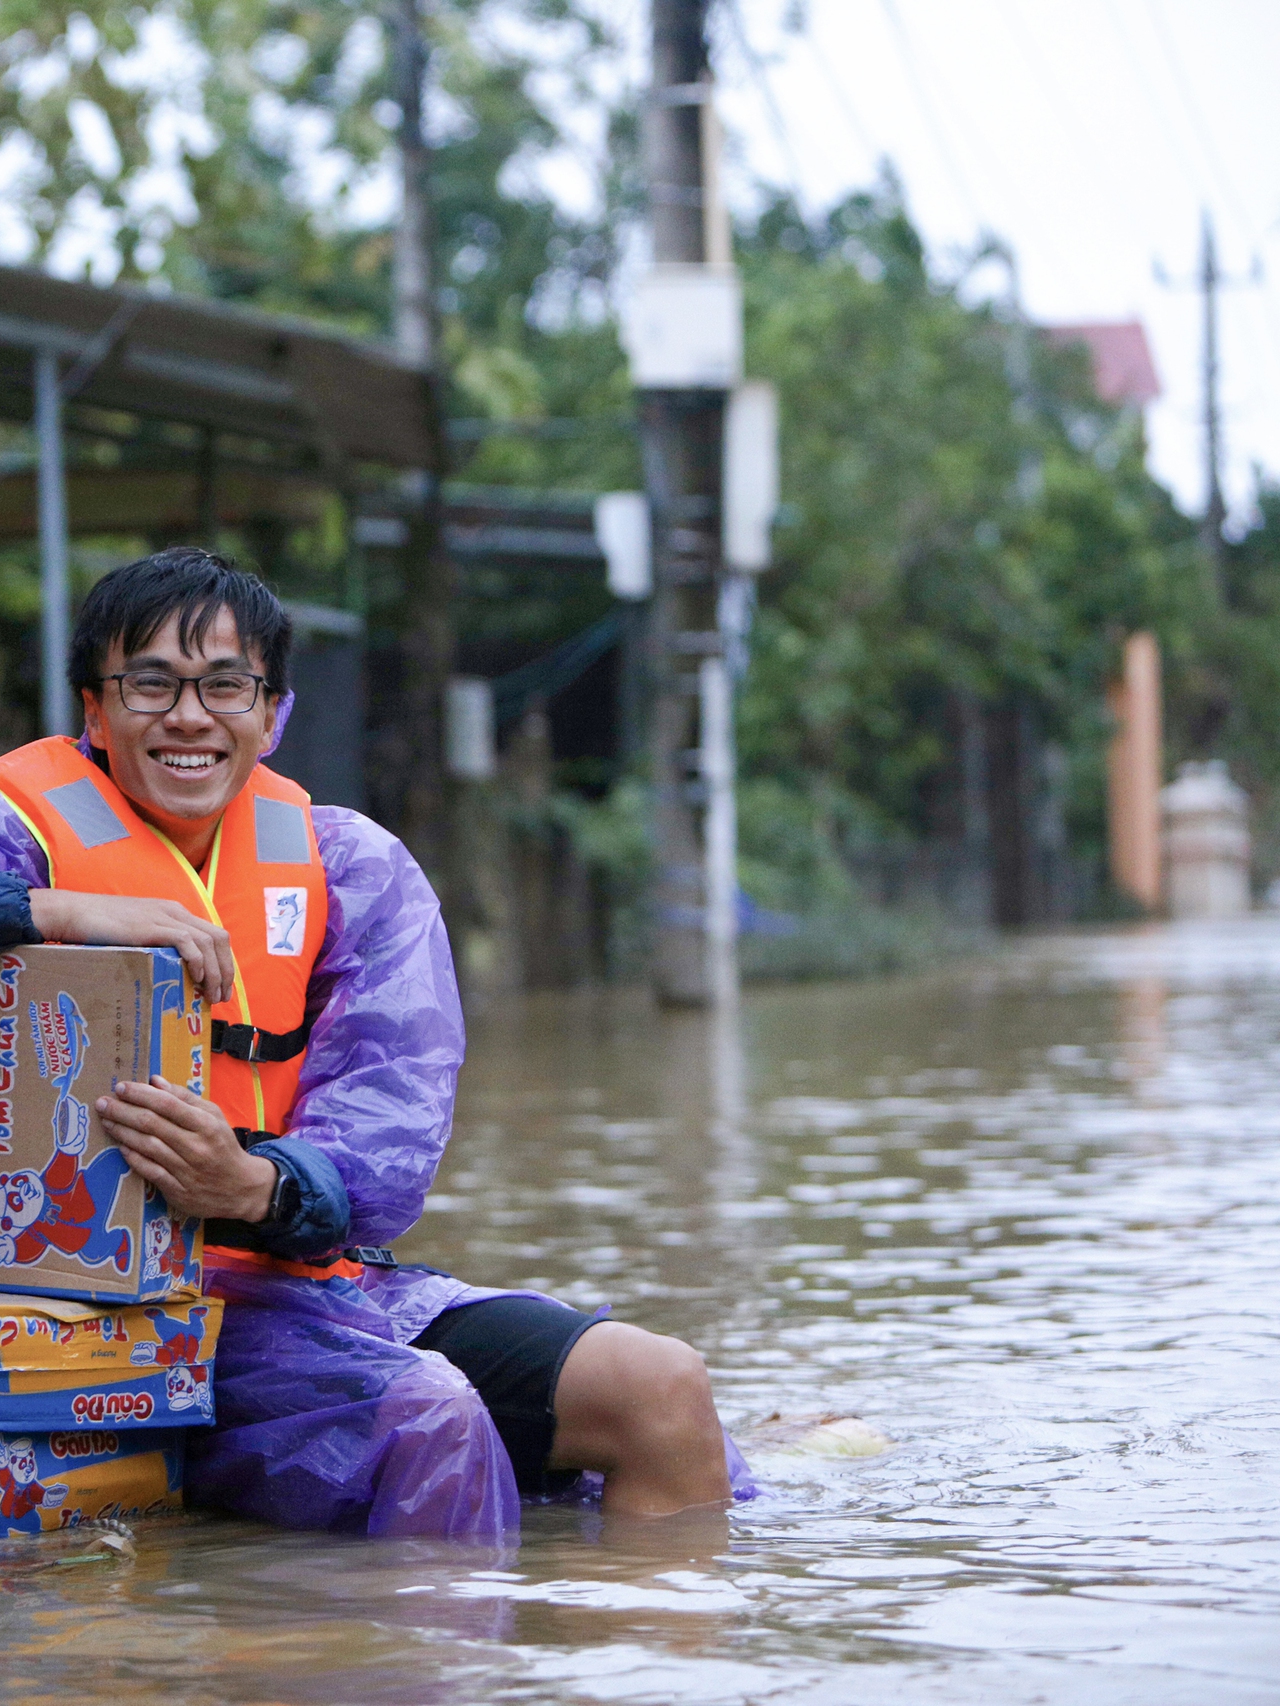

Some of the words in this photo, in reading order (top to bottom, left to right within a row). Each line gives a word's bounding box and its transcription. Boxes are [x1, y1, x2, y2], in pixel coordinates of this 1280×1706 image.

[55, 1013, 69, 1044] CƠM
[45, 1037, 61, 1073] NƯỚC
[59, 1048, 72, 1066] CÁ
[186, 1049, 204, 1096] hua
[24, 1318, 75, 1345] Chua
[82, 1316, 127, 1342] Tôm
